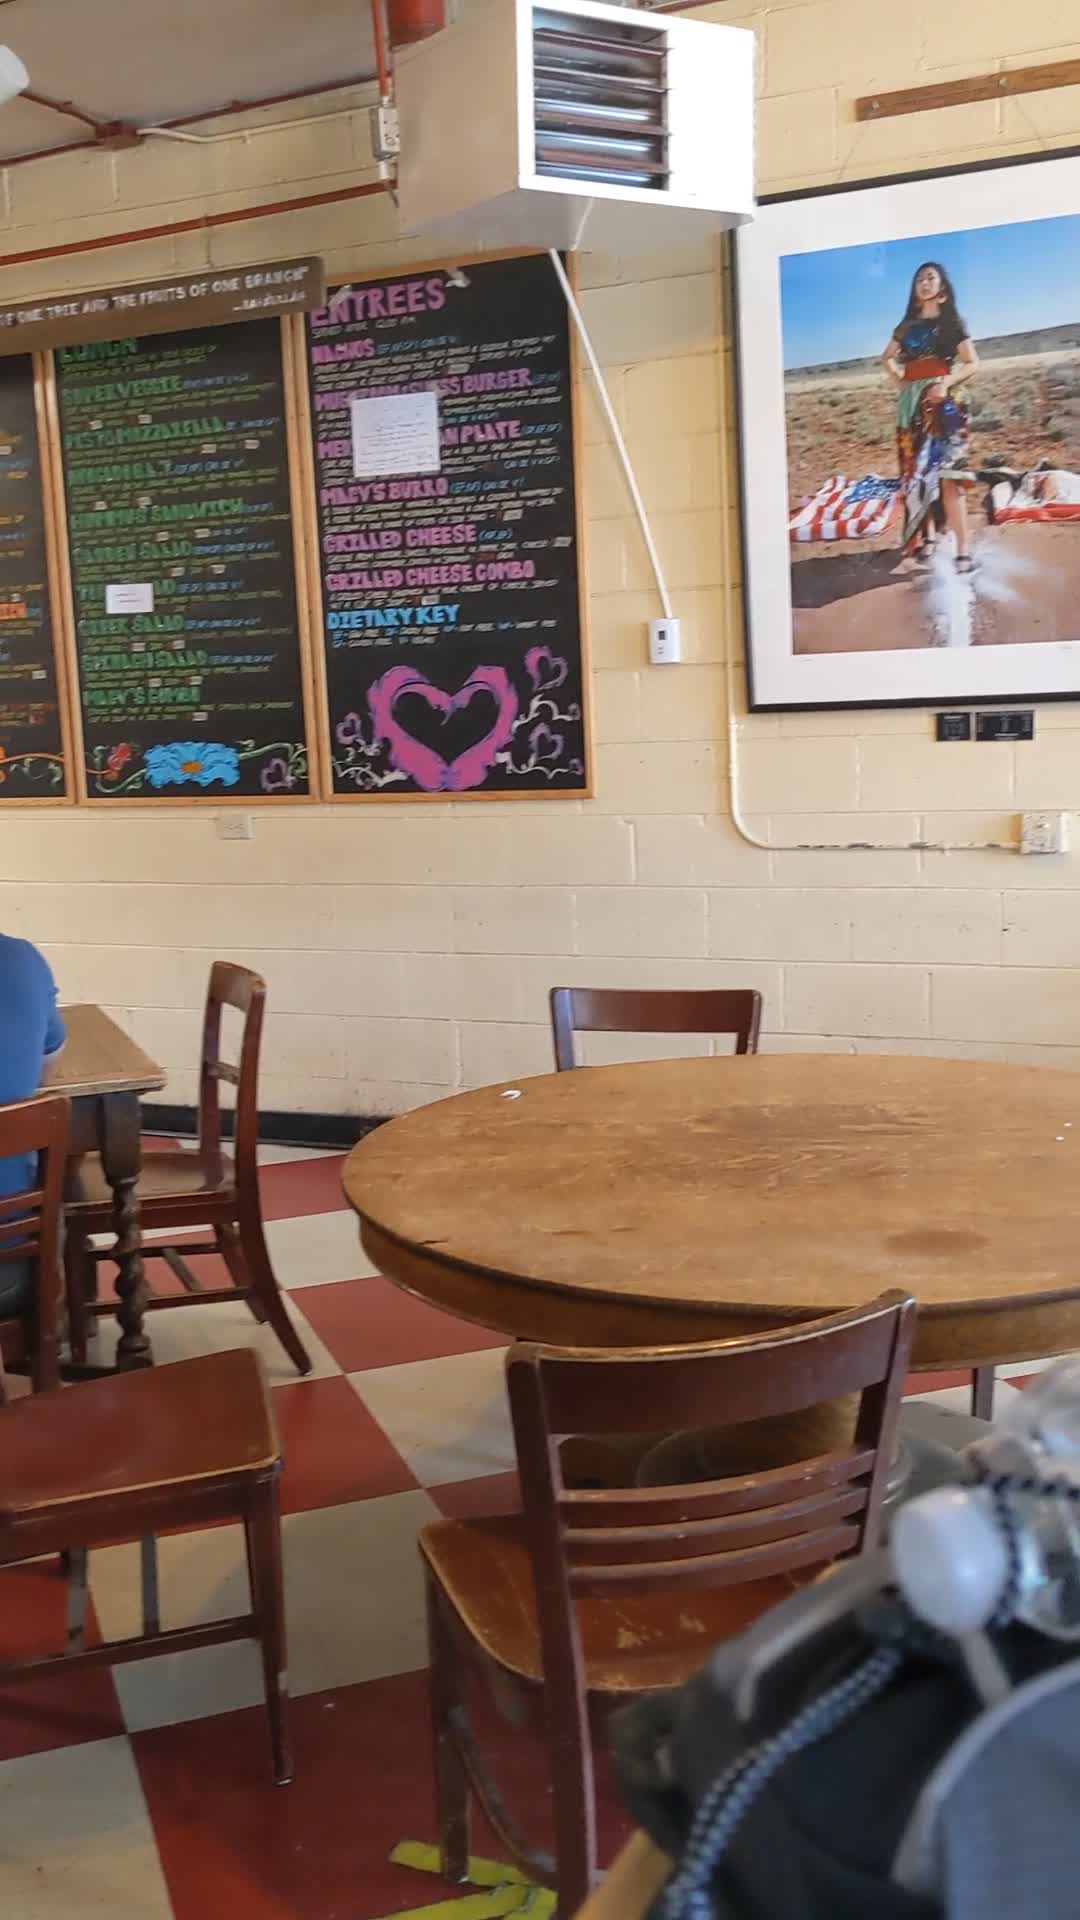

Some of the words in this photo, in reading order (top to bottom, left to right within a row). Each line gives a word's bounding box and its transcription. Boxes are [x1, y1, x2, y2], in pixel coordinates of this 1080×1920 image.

[17, 308, 45, 323] ONE
[47, 304, 80, 318] TREE
[82, 299, 110, 314] AND
[112, 294, 137, 308] THE
[140, 287, 186, 304] FRUITS
[189, 283, 208, 297] OF
[212, 277, 240, 293] ONE
[311, 278, 446, 329] ENTREES
[312, 338, 375, 364] NACHOS
[463, 368, 532, 394] BURGER
[460, 419, 522, 443] PLATE
[387, 477, 448, 500] BURRO
[323, 530, 403, 554] GRILLED
[405, 524, 477, 548] CHEESE
[325, 570, 404, 592] GRILLED
[406, 564, 473, 587] CHEESE
[475, 560, 536, 581] COMBO
[327, 607, 413, 630] DIETARY
[415, 604, 461, 625] KEY
